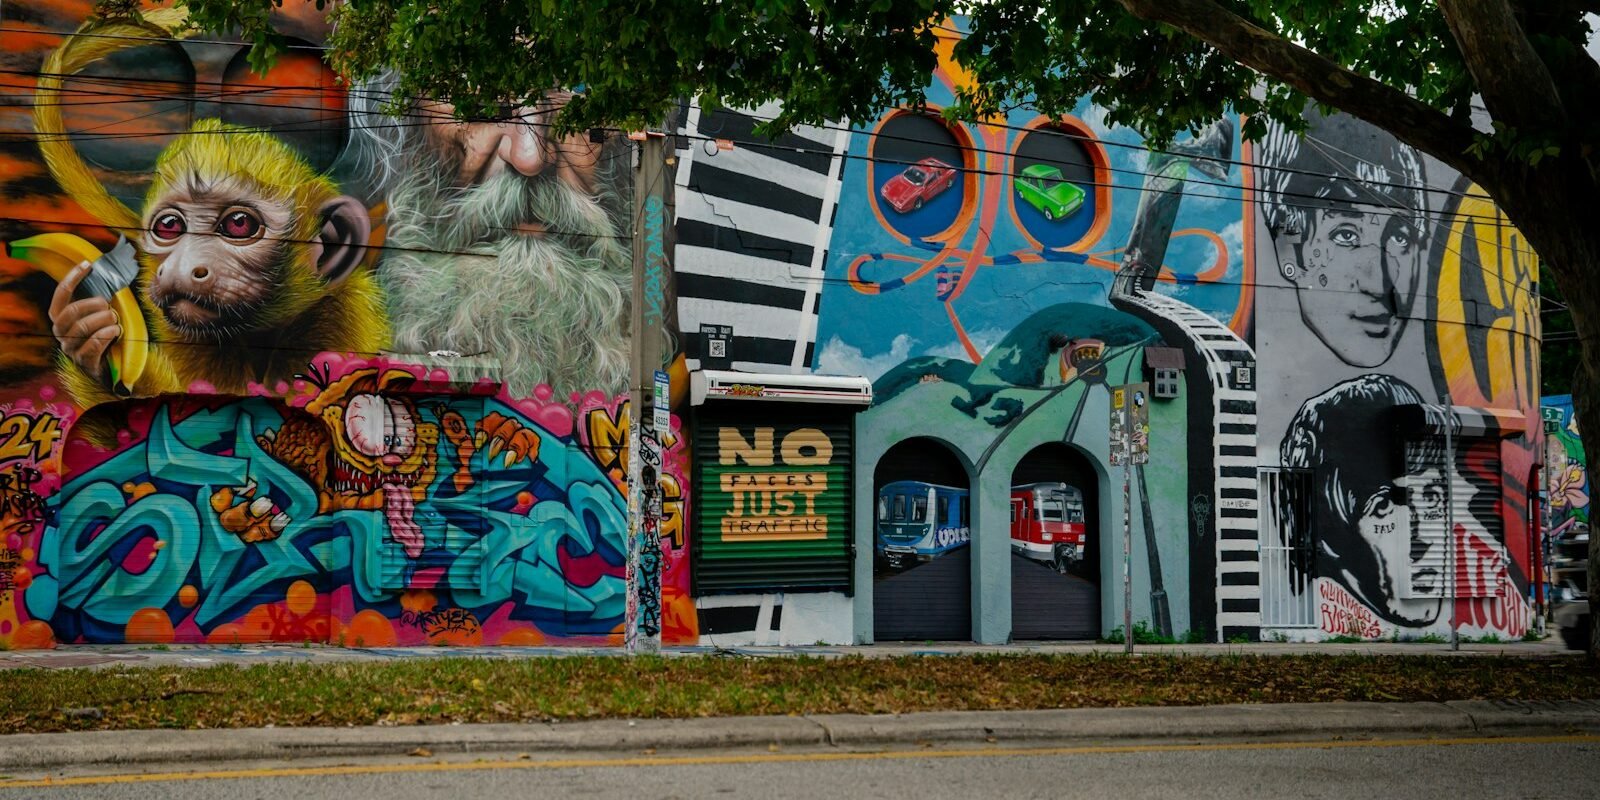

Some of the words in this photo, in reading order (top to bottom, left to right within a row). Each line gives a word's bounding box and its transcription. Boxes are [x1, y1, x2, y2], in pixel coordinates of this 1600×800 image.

[1545, 409, 1552, 419] 5
[718, 427, 833, 466] NO
[731, 474, 814, 487] FACES
[727, 490, 823, 518] JUST
[726, 519, 823, 533] TRAFFIC
